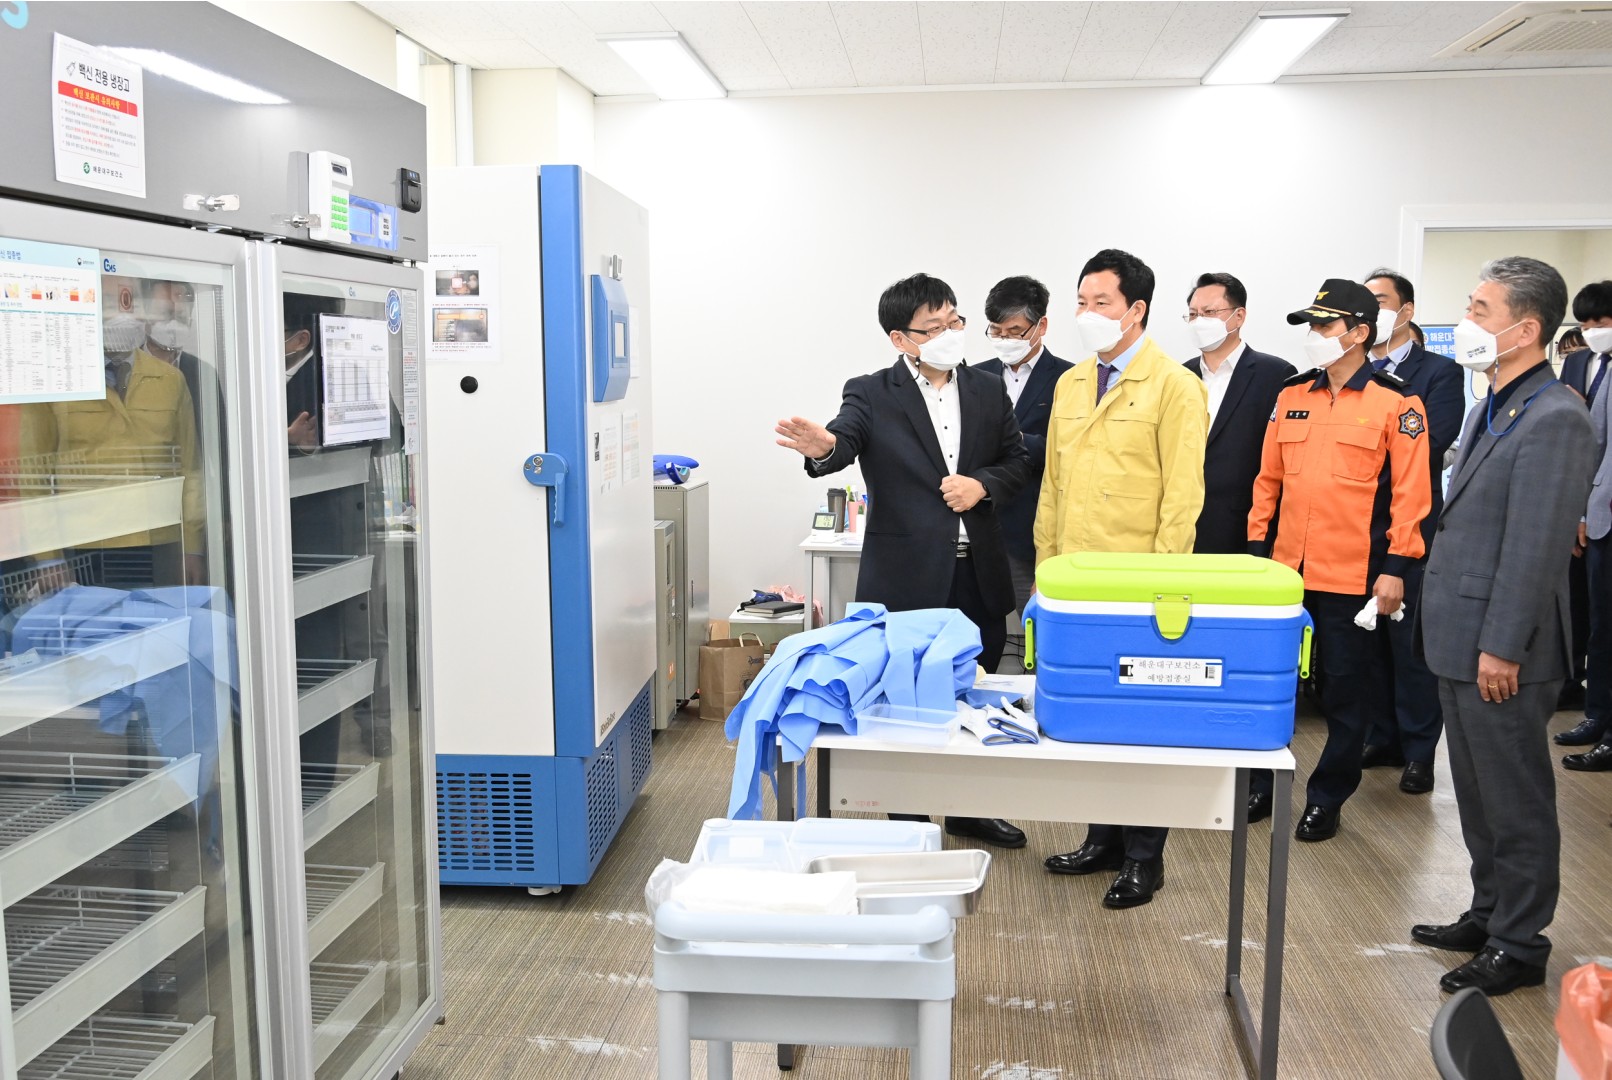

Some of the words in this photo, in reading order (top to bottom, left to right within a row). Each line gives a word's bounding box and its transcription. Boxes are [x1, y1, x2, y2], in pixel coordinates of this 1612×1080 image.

[78, 62, 92, 81] 백신
[94, 68, 108, 86] 전용
[110, 73, 130, 92] 냉장고
[93, 166, 123, 178] 해운대구보건소
[1138, 660, 1200, 670] 해운대구보건소
[1148, 674, 1192, 683] 예방접종실
